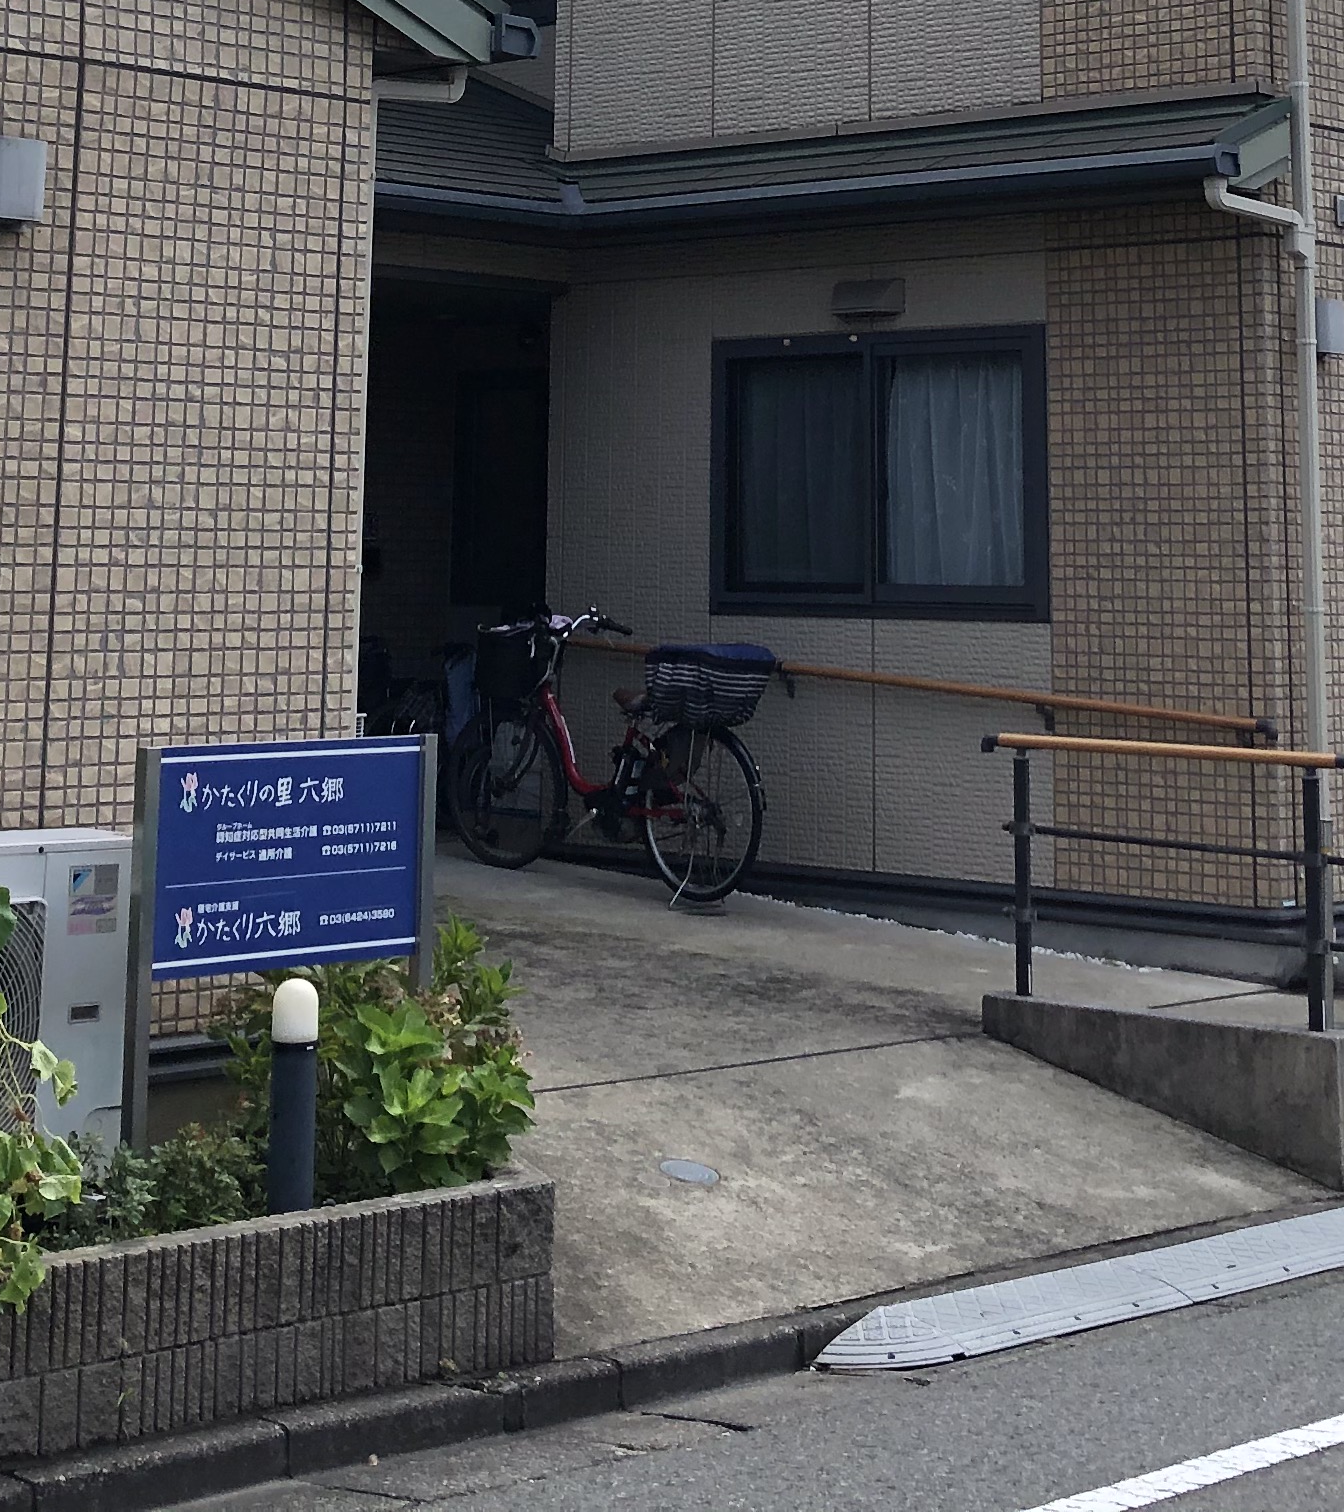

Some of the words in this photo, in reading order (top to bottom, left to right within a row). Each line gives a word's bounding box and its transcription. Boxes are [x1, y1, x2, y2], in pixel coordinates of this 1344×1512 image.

[197, 911, 301, 946] かたくり六郷
